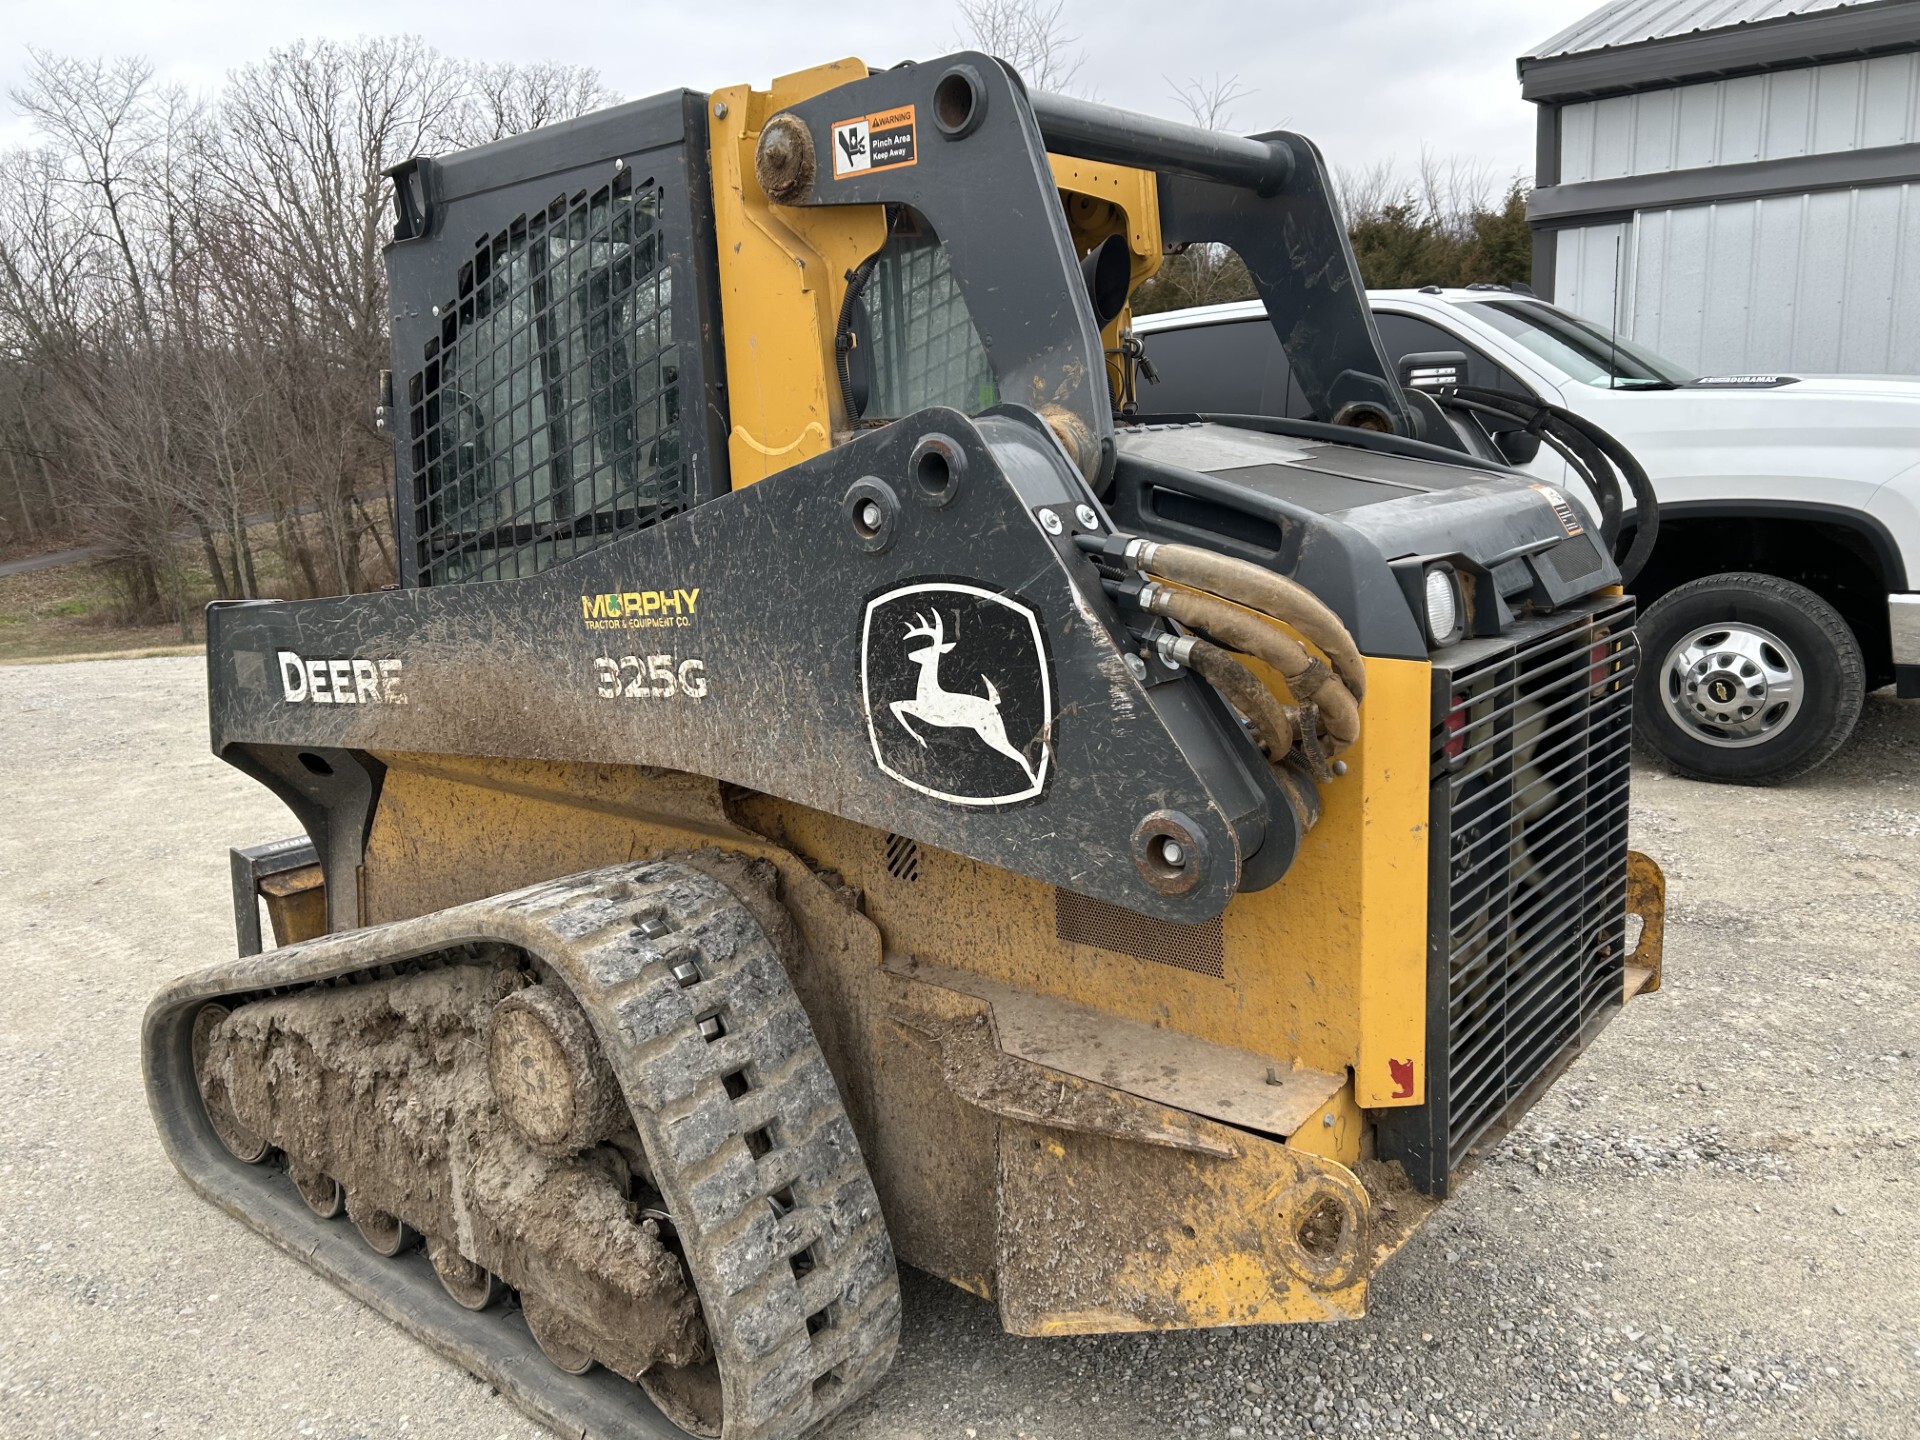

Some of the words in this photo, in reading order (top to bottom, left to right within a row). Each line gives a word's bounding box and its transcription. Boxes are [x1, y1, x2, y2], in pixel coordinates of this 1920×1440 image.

[879, 112, 911, 126] WARNING
[872, 137, 893, 149] Pinch
[894, 134, 911, 145] Area
[872, 151, 889, 161] Keep
[889, 148, 906, 157] Away
[581, 588, 700, 619] MURPHY
[585, 619, 620, 630] TRACTOR
[629, 617, 674, 629] EQUIPMENT
[676, 616, 692, 627] CO.
[277, 651, 409, 705] DEERE
[594, 655, 708, 699] 325G
